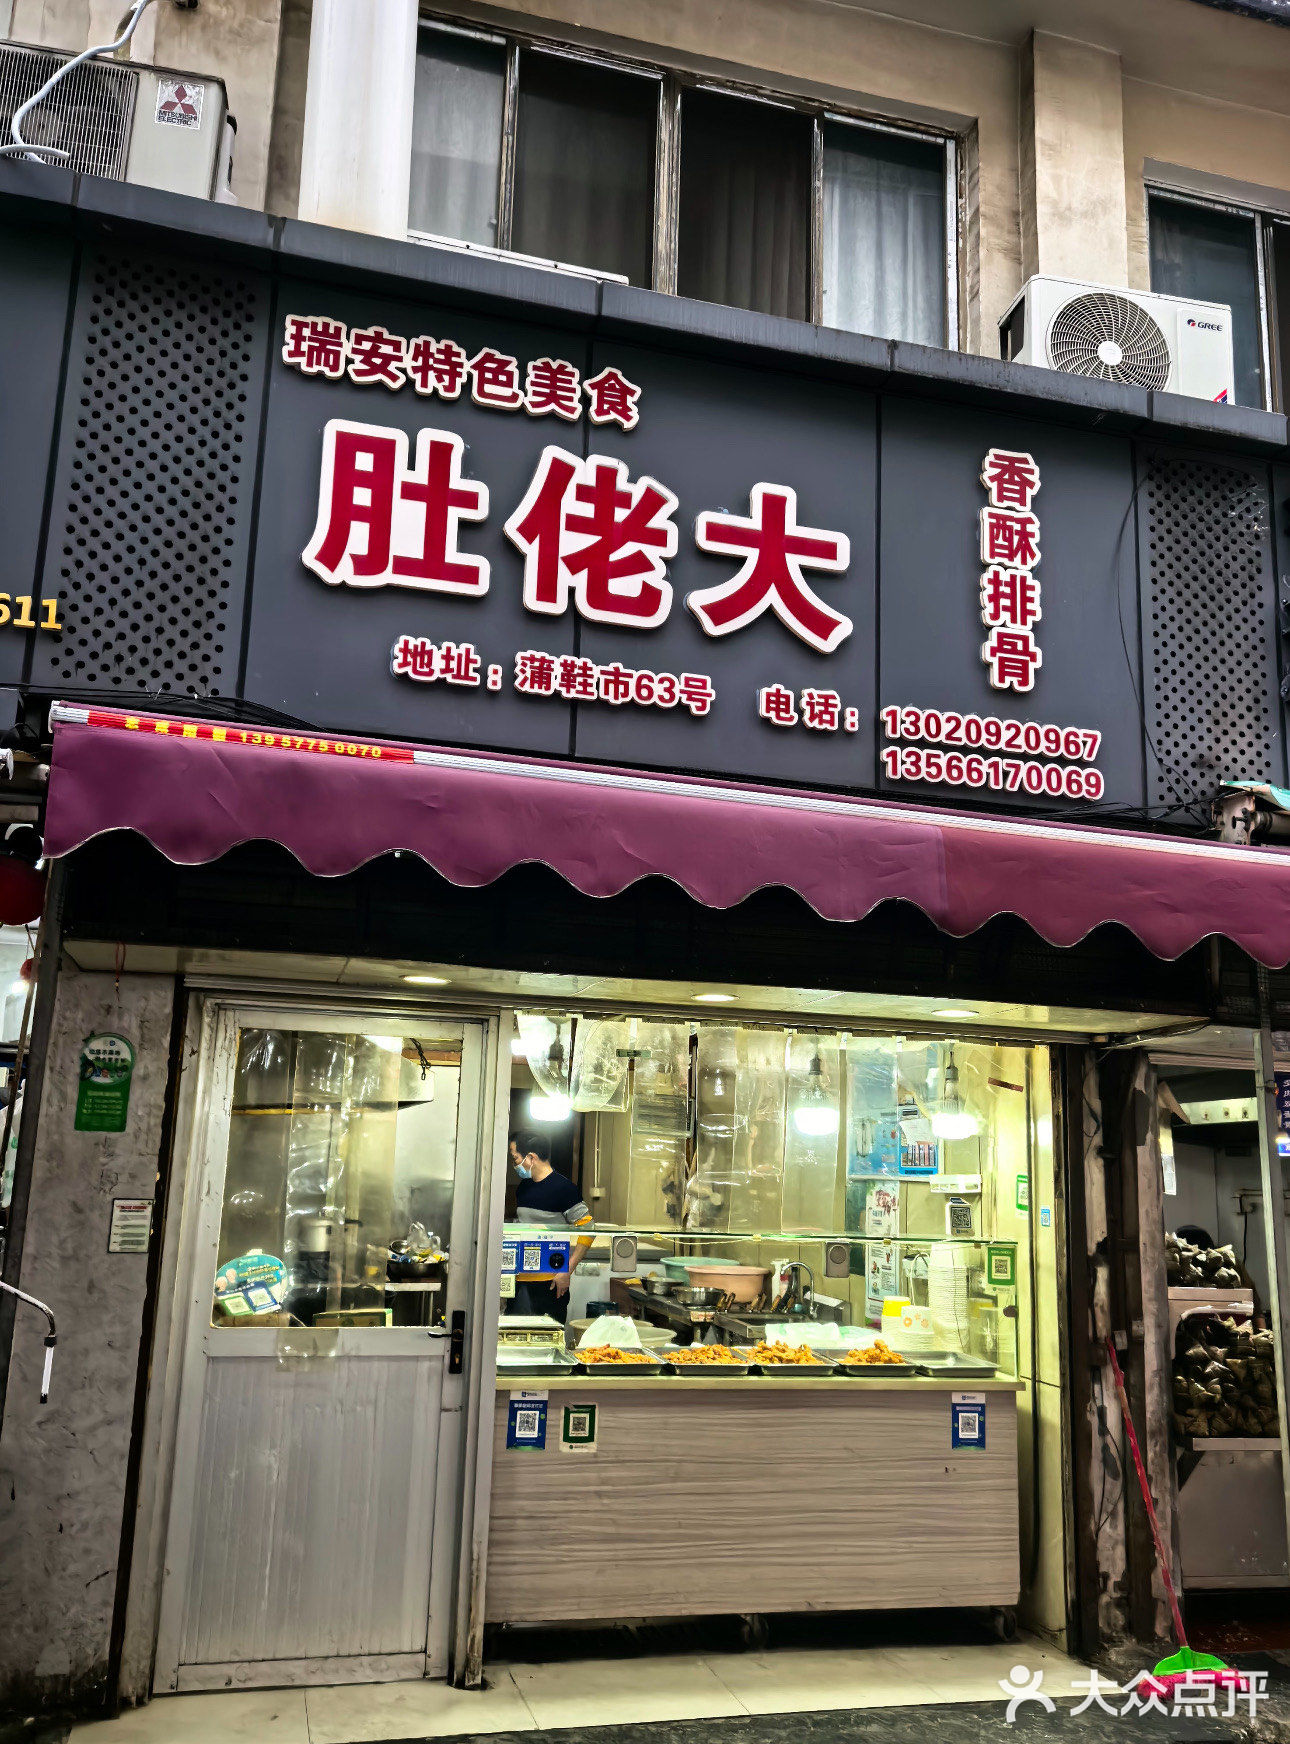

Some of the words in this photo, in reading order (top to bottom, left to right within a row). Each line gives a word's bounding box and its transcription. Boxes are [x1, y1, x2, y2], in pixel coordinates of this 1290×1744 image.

[157, 115, 193, 126] ELECTRIC
[1197, 321, 1223, 332] GREE
[281, 314, 642, 430] 瑞安特色美食
[302, 418, 854, 653] 肚佬大
[980, 448, 1043, 692] 香酥排骨
[758, 682, 860, 732] 电话：
[880, 704, 1102, 762] 13020920967
[880, 745, 1105, 801] 13566170069
